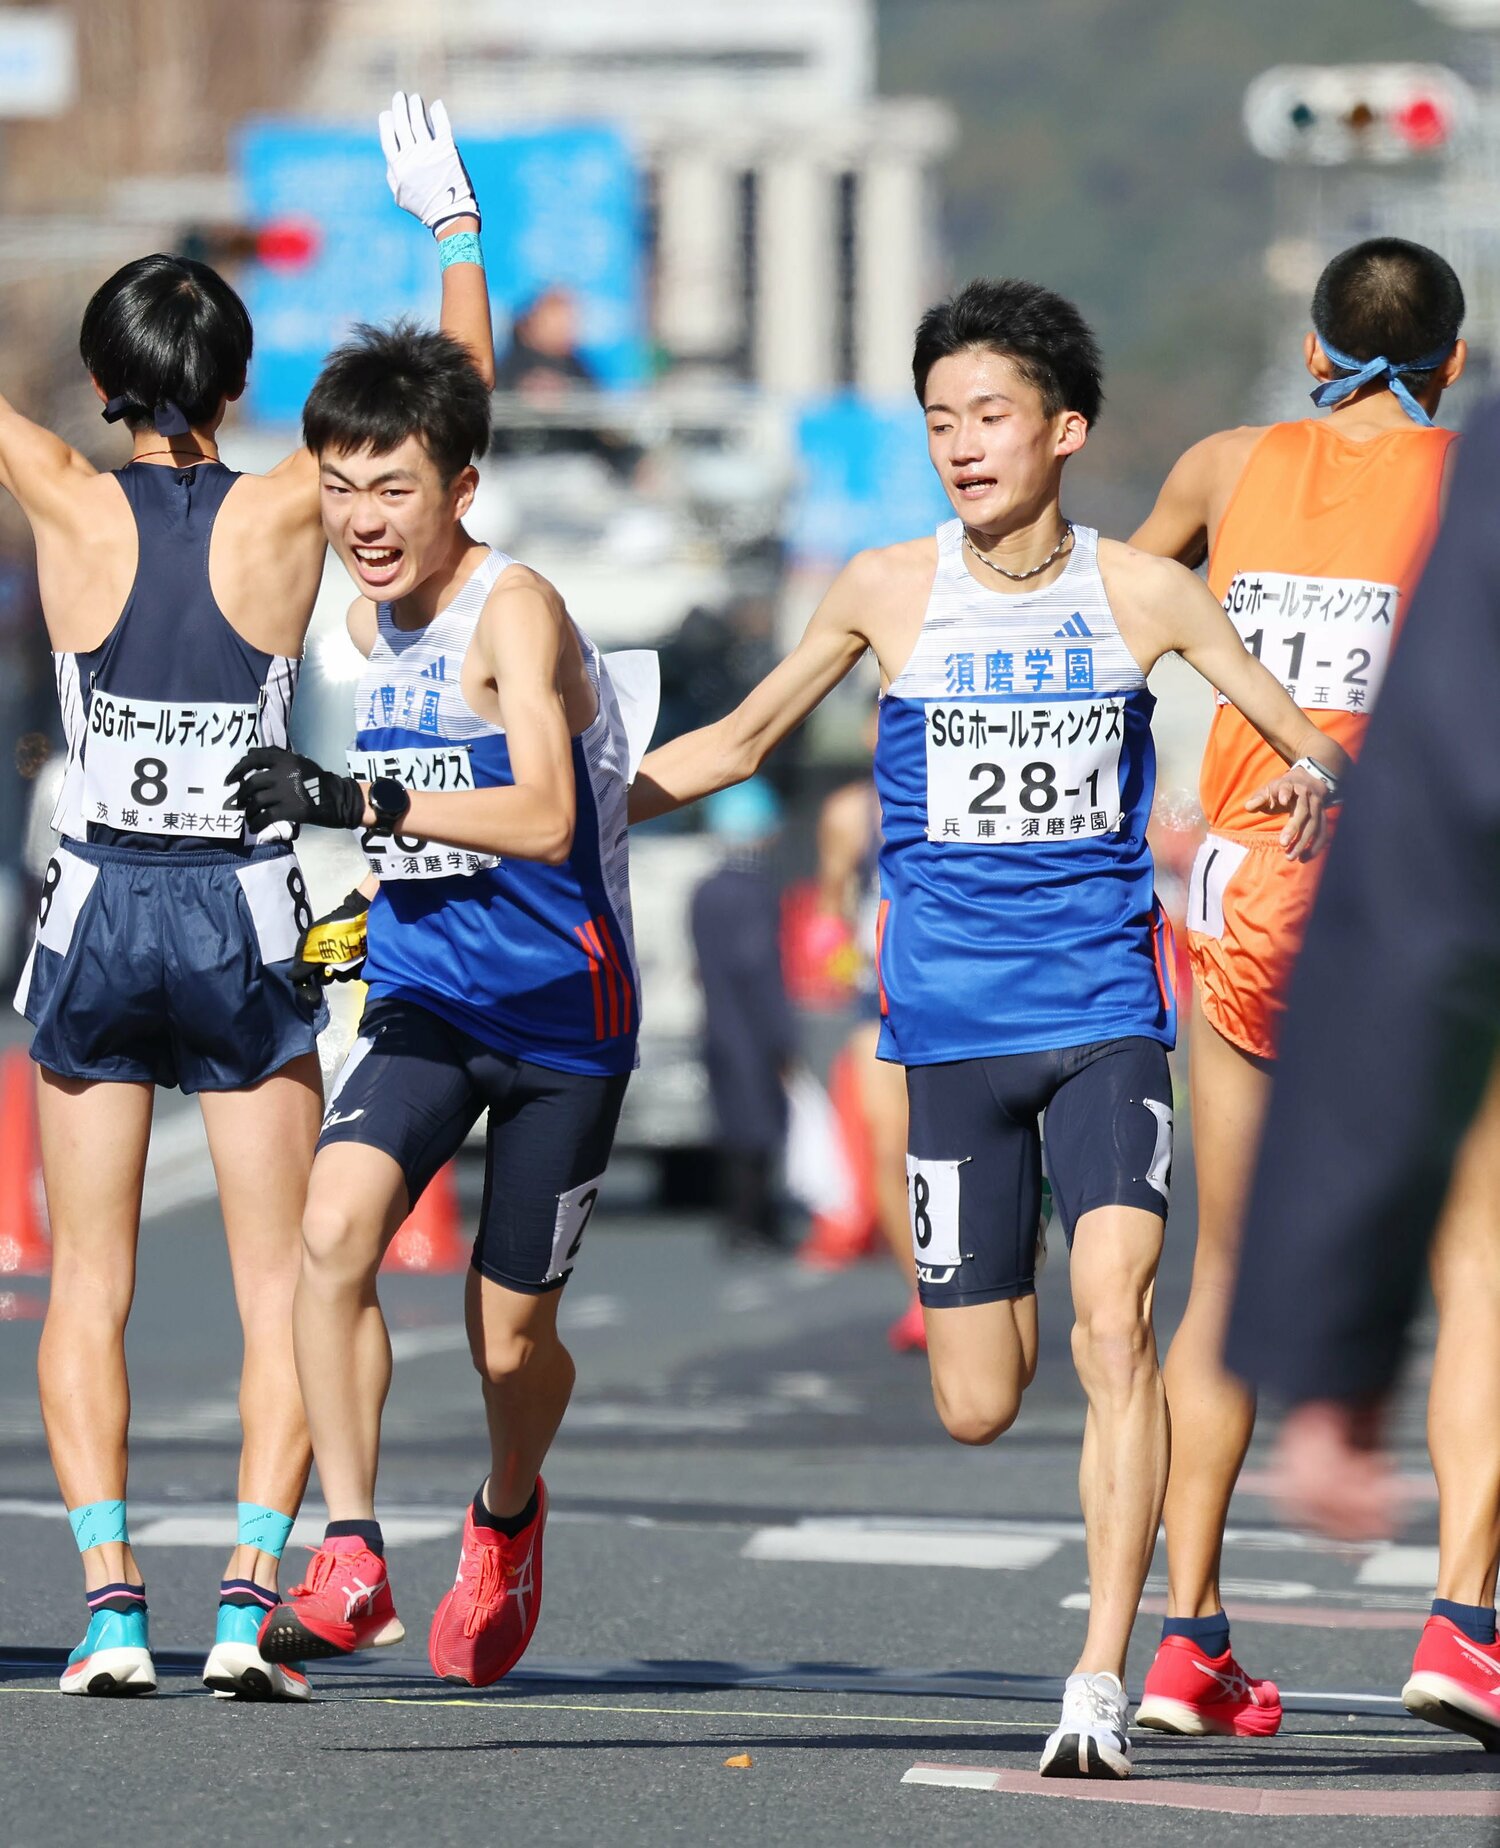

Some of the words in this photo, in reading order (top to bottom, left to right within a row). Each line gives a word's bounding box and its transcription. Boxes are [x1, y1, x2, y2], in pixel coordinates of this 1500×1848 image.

[1224, 577, 1391, 625] SGホールディングス
[945, 648, 1094, 694] 須磨学園
[91, 697, 260, 748] SGホールディングス
[931, 704, 1121, 749] SGホールディングス
[347, 753, 469, 790] ールディングス
[968, 761, 1101, 815] 28-1
[942, 811, 1109, 837] 兵庫・須磨学園
[38, 857, 62, 929] 8
[286, 867, 313, 931] 8
